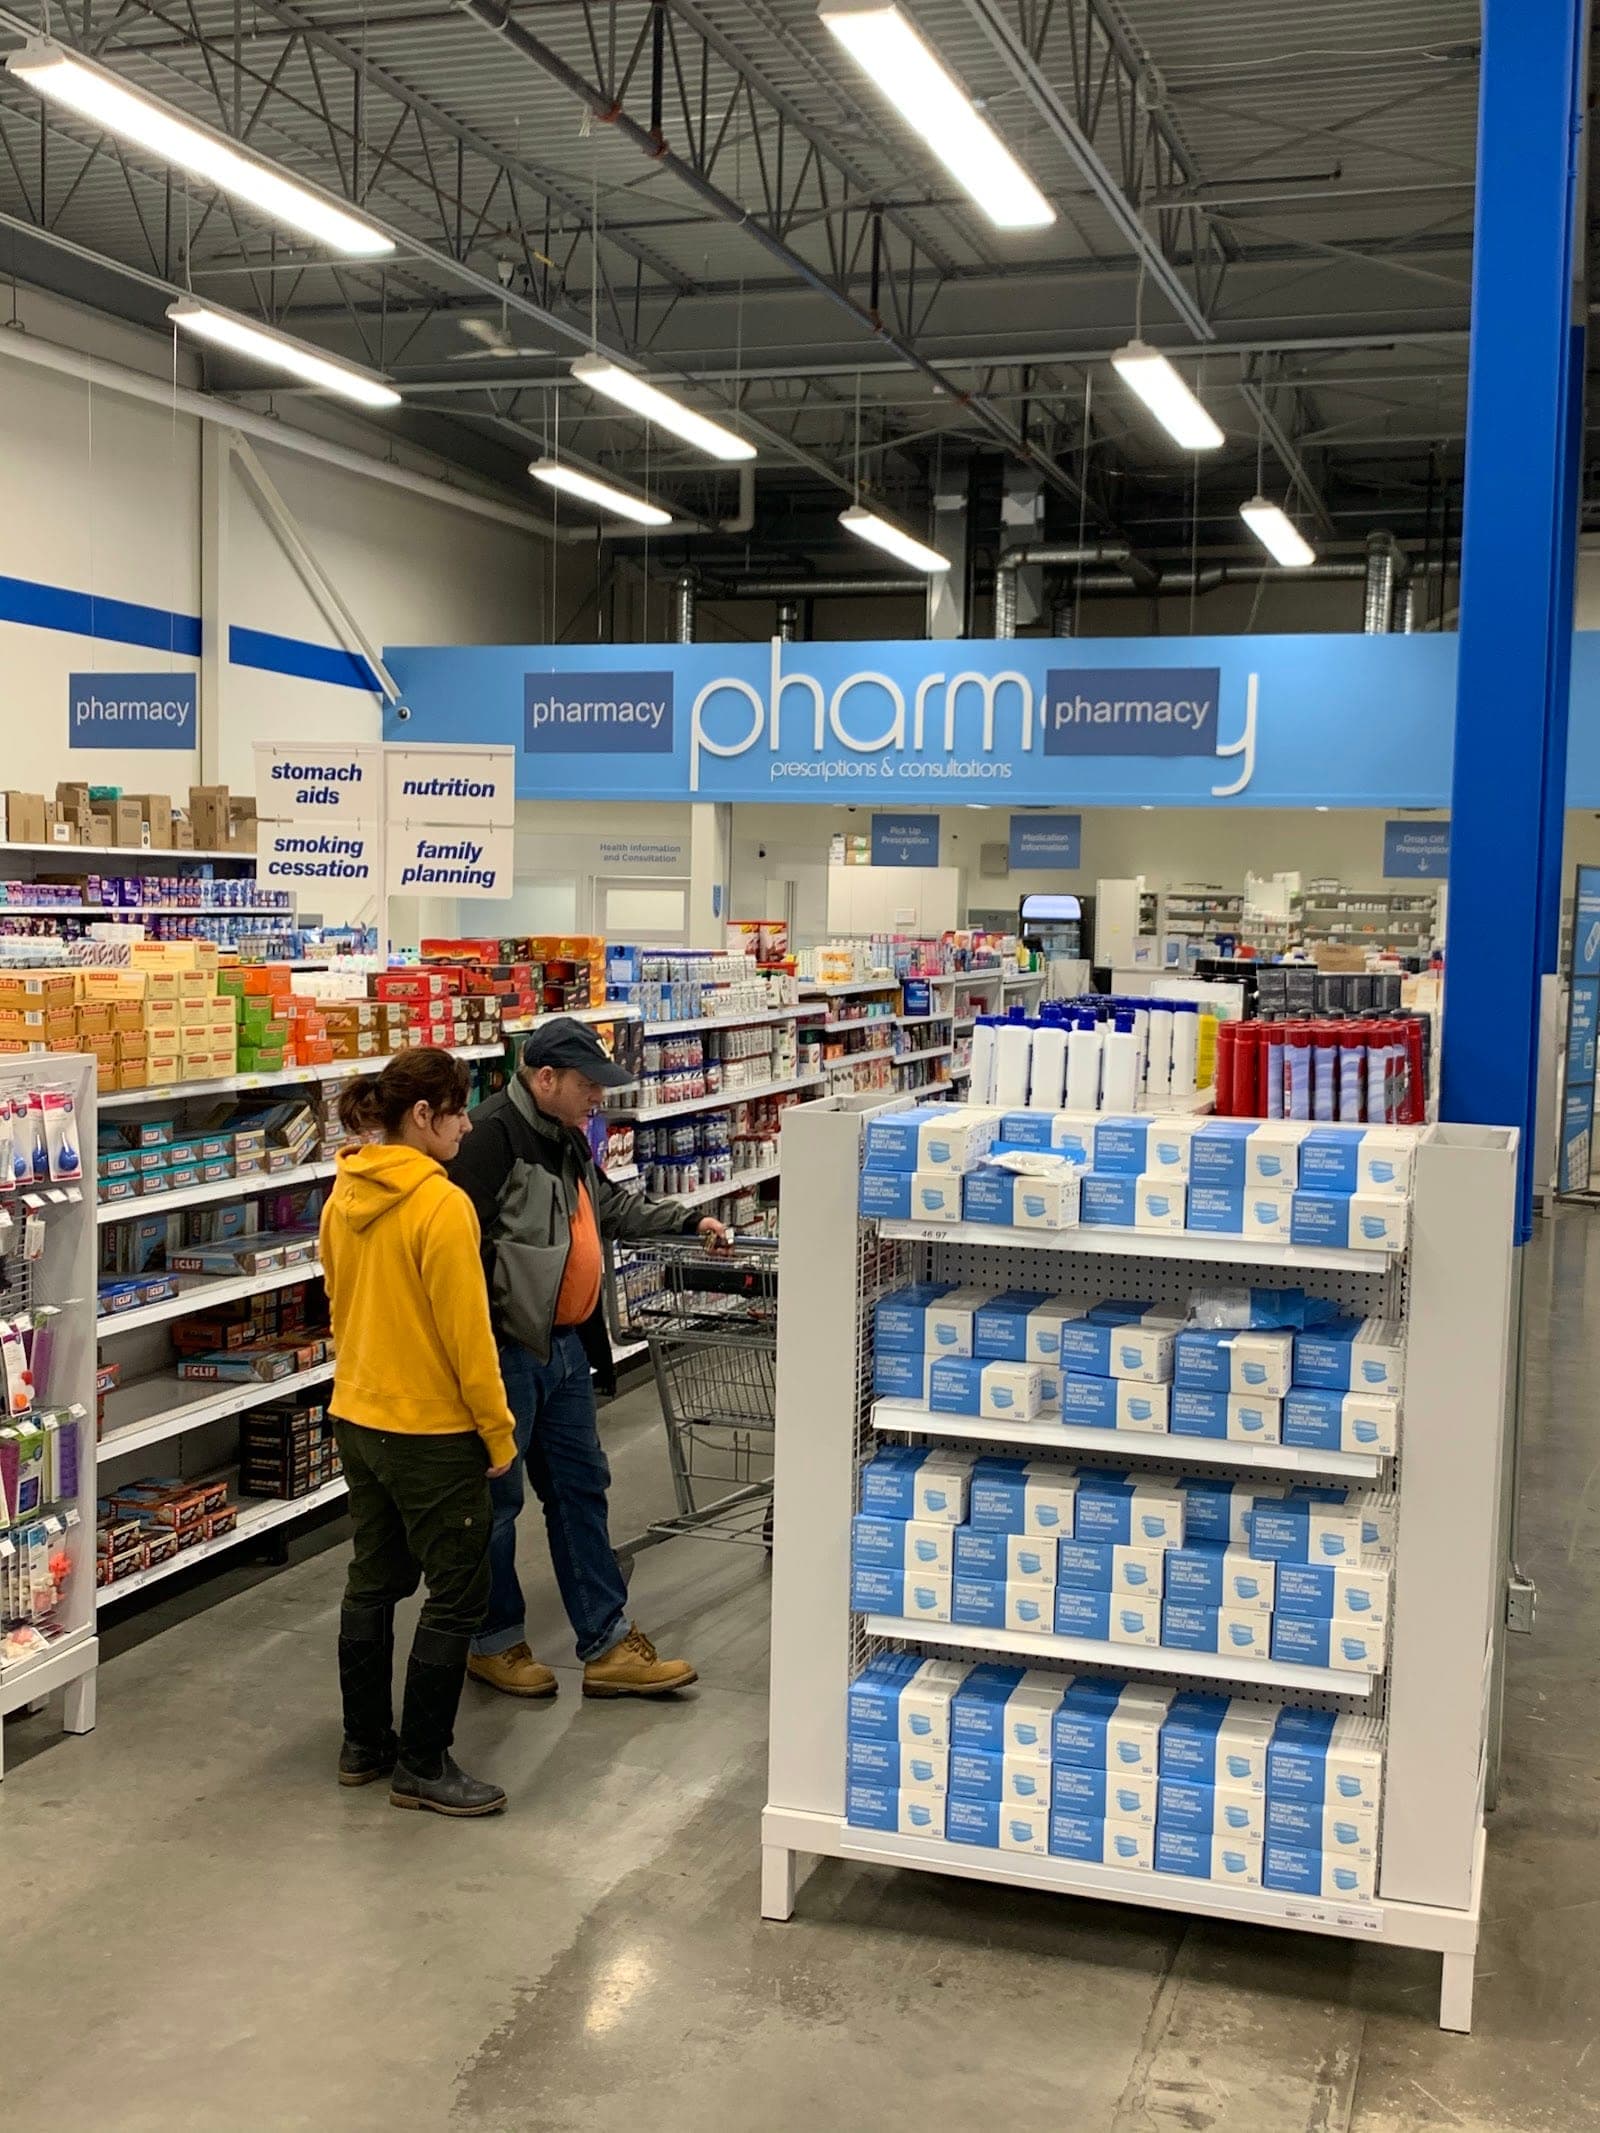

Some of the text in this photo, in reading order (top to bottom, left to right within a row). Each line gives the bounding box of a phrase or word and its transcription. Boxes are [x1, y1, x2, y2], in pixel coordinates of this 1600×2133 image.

[76, 696, 189, 727] pharmacy
[533, 697, 665, 729] pharmacy
[690, 636, 1257, 795] pharmy
[1055, 696, 1209, 729] pharmacy
[271, 762, 362, 782] stomach
[770, 757, 1012, 783] prescriptions & consultations
[296, 786, 339, 804] aids
[402, 778, 495, 798] nutrition
[274, 836, 363, 859] smoking
[417, 841, 482, 863] family
[600, 843, 627, 852] Health
[622, 854, 677, 863] Consultation
[268, 859, 369, 879] cessation
[402, 864, 496, 888] planning
[179, 1259, 201, 1269] CLIF
[120, 1294, 132, 1305] CLIF
[192, 1367, 216, 1377] CLIF
